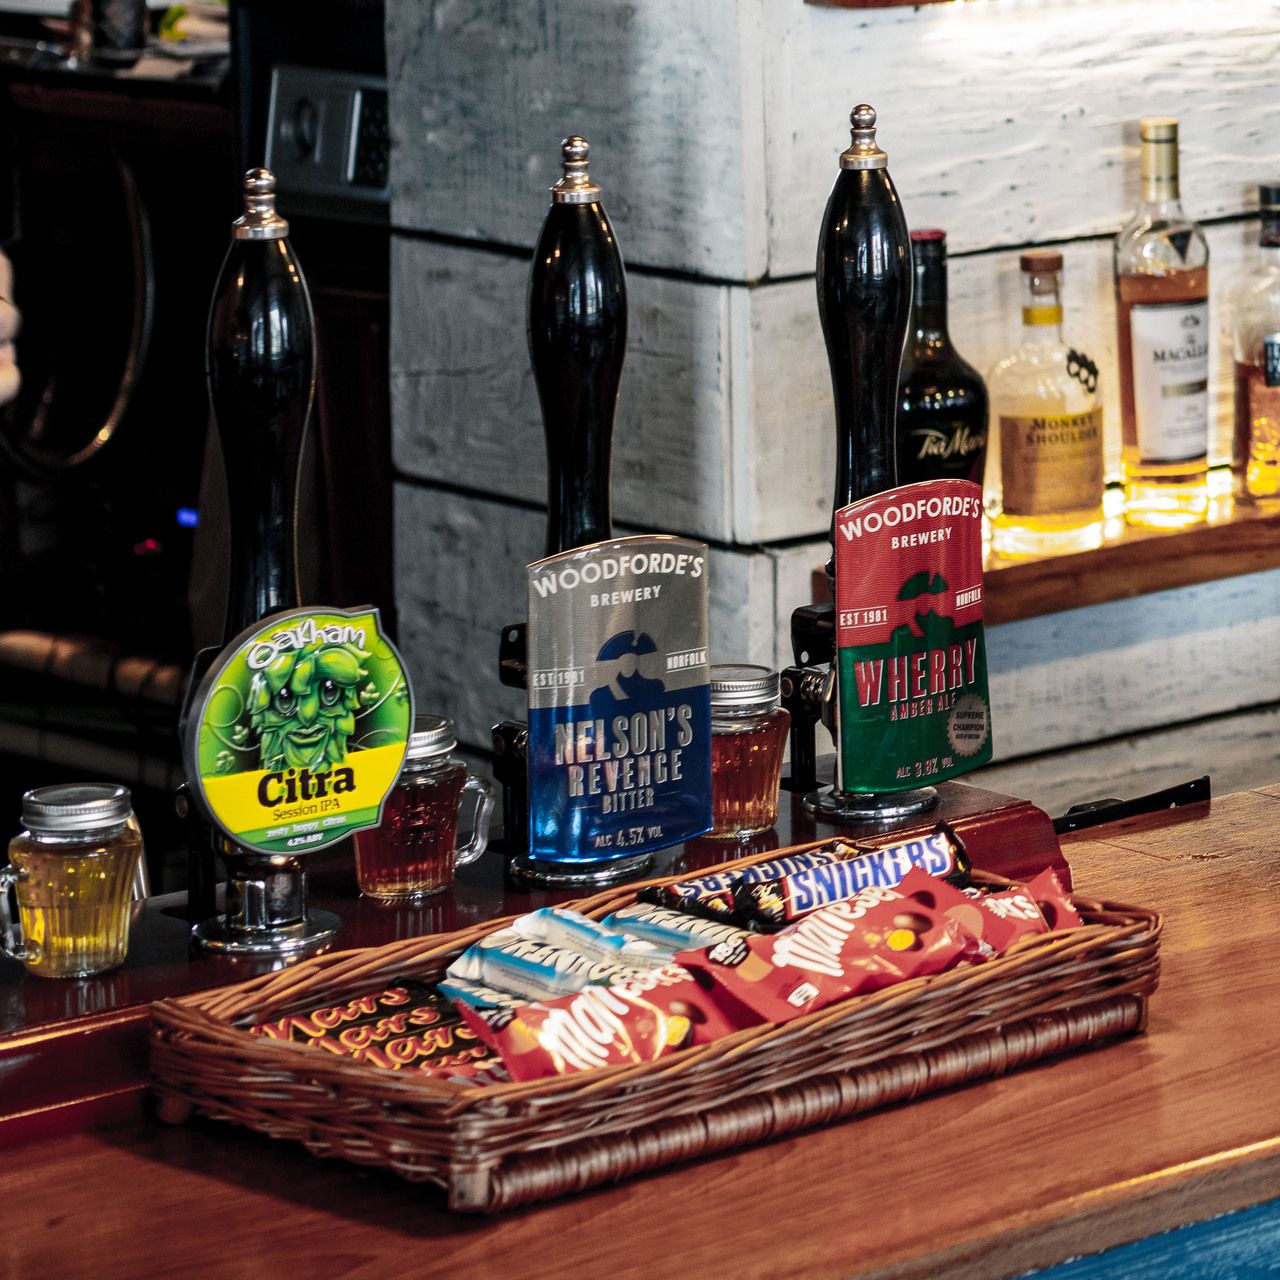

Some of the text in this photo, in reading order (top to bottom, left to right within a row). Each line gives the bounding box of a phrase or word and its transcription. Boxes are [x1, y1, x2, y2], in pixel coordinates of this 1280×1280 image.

[839, 496, 980, 542] WOODFORDE'S
[892, 527, 953, 550] BREWERY
[533, 553, 704, 598] WOODFORDE'S
[590, 585, 662, 608] BREWERY
[956, 591, 981, 608] NORFOLK
[840, 609, 887, 626] EST 1981
[247, 619, 366, 670] Oakham
[666, 649, 707, 670] NORFOLK
[533, 669, 584, 688] EST 1981
[854, 638, 977, 708] WHERRY
[889, 692, 957, 722] AMBER ALE
[955, 711, 985, 720] SUPREME
[555, 704, 693, 767] NELSON'S
[953, 723, 985, 732] CHAMPION
[568, 749, 683, 797] REVENGE
[257, 766, 356, 808] Citra
[273, 798, 341, 821] Session IPA
[602, 788, 655, 814] BITTER
[595, 825, 663, 848] ALC 4.5% VOL
[791, 833, 949, 912] SNICKERS
